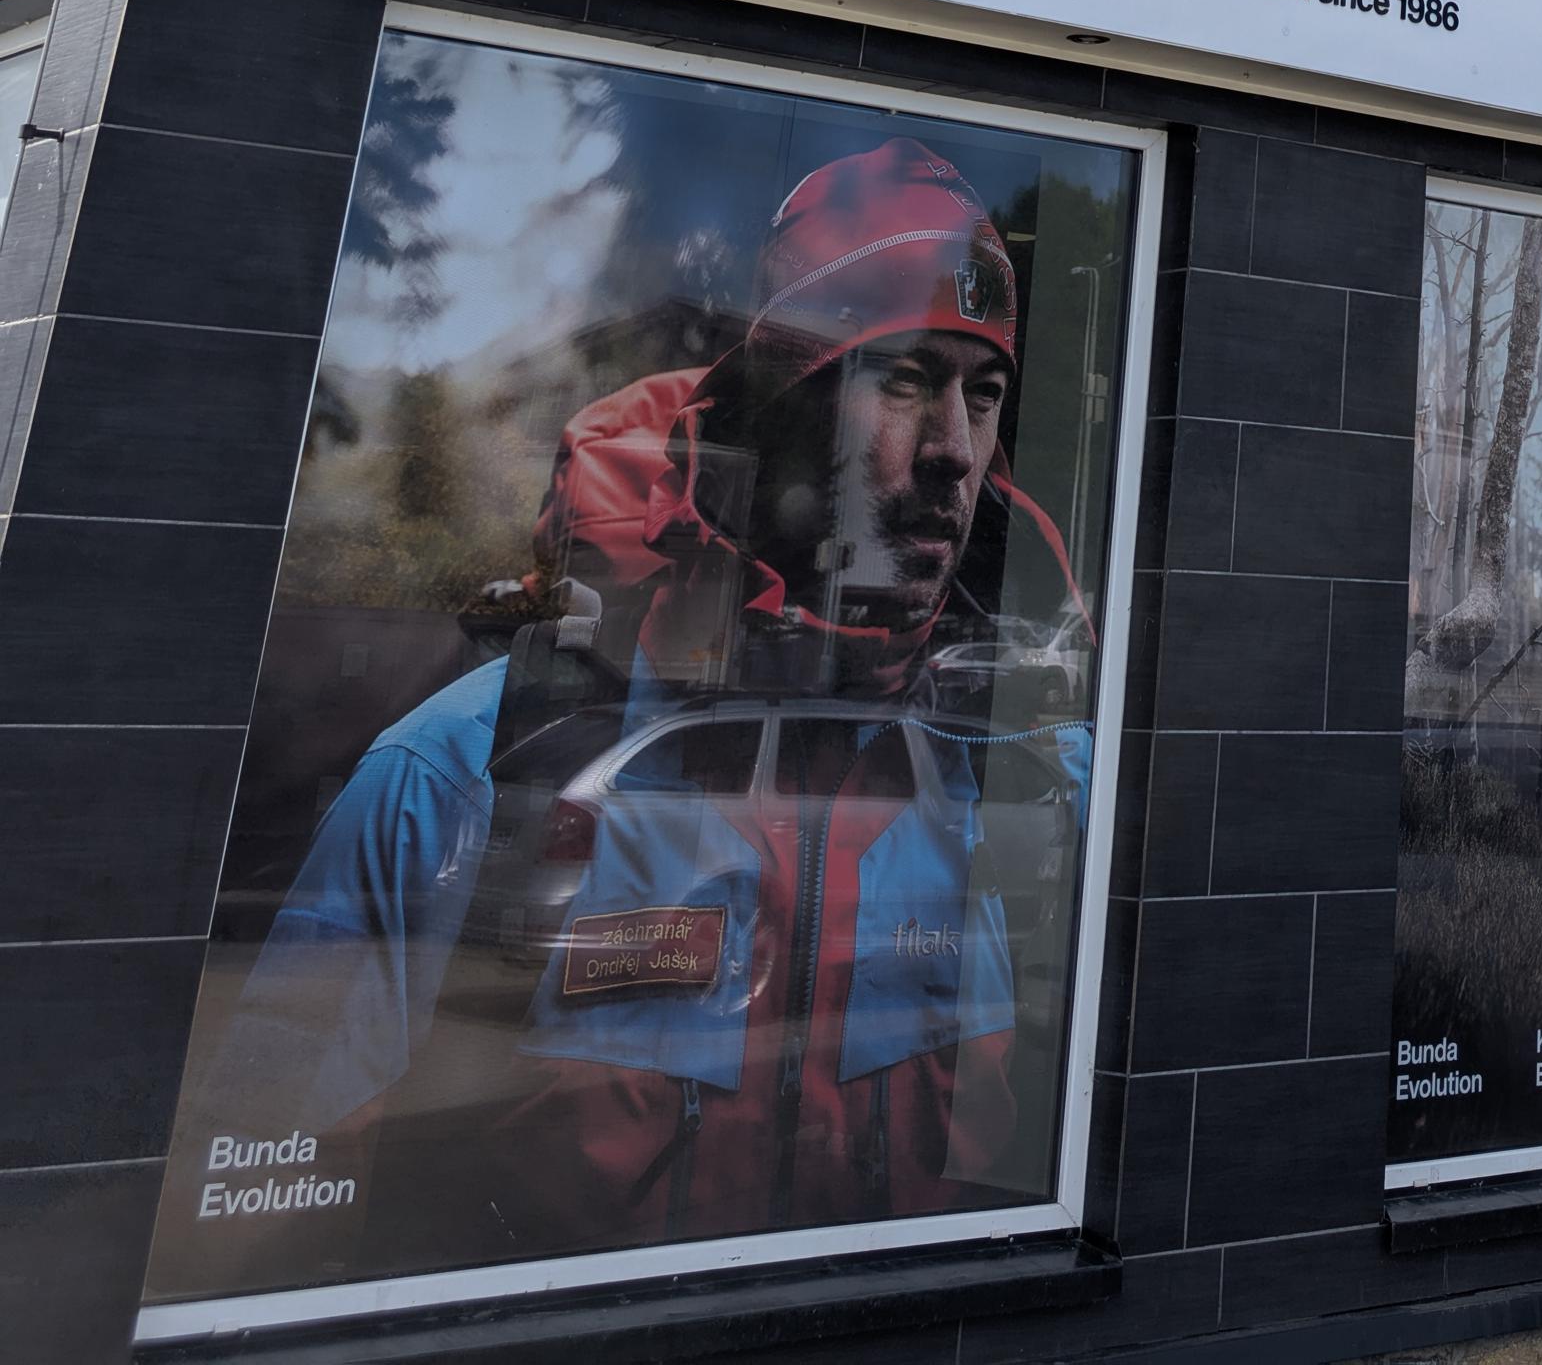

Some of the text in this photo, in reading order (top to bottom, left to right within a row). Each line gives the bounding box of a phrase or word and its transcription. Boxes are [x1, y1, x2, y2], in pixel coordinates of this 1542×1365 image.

[602, 917, 695, 947] záchranář
[892, 916, 961, 958] tilak
[649, 948, 699, 972] Jašek
[1398, 1037, 1458, 1066] Bunda
[1396, 1071, 1483, 1100] Evolution
[208, 1131, 318, 1170] Bunda
[198, 1175, 356, 1217] Evolution
